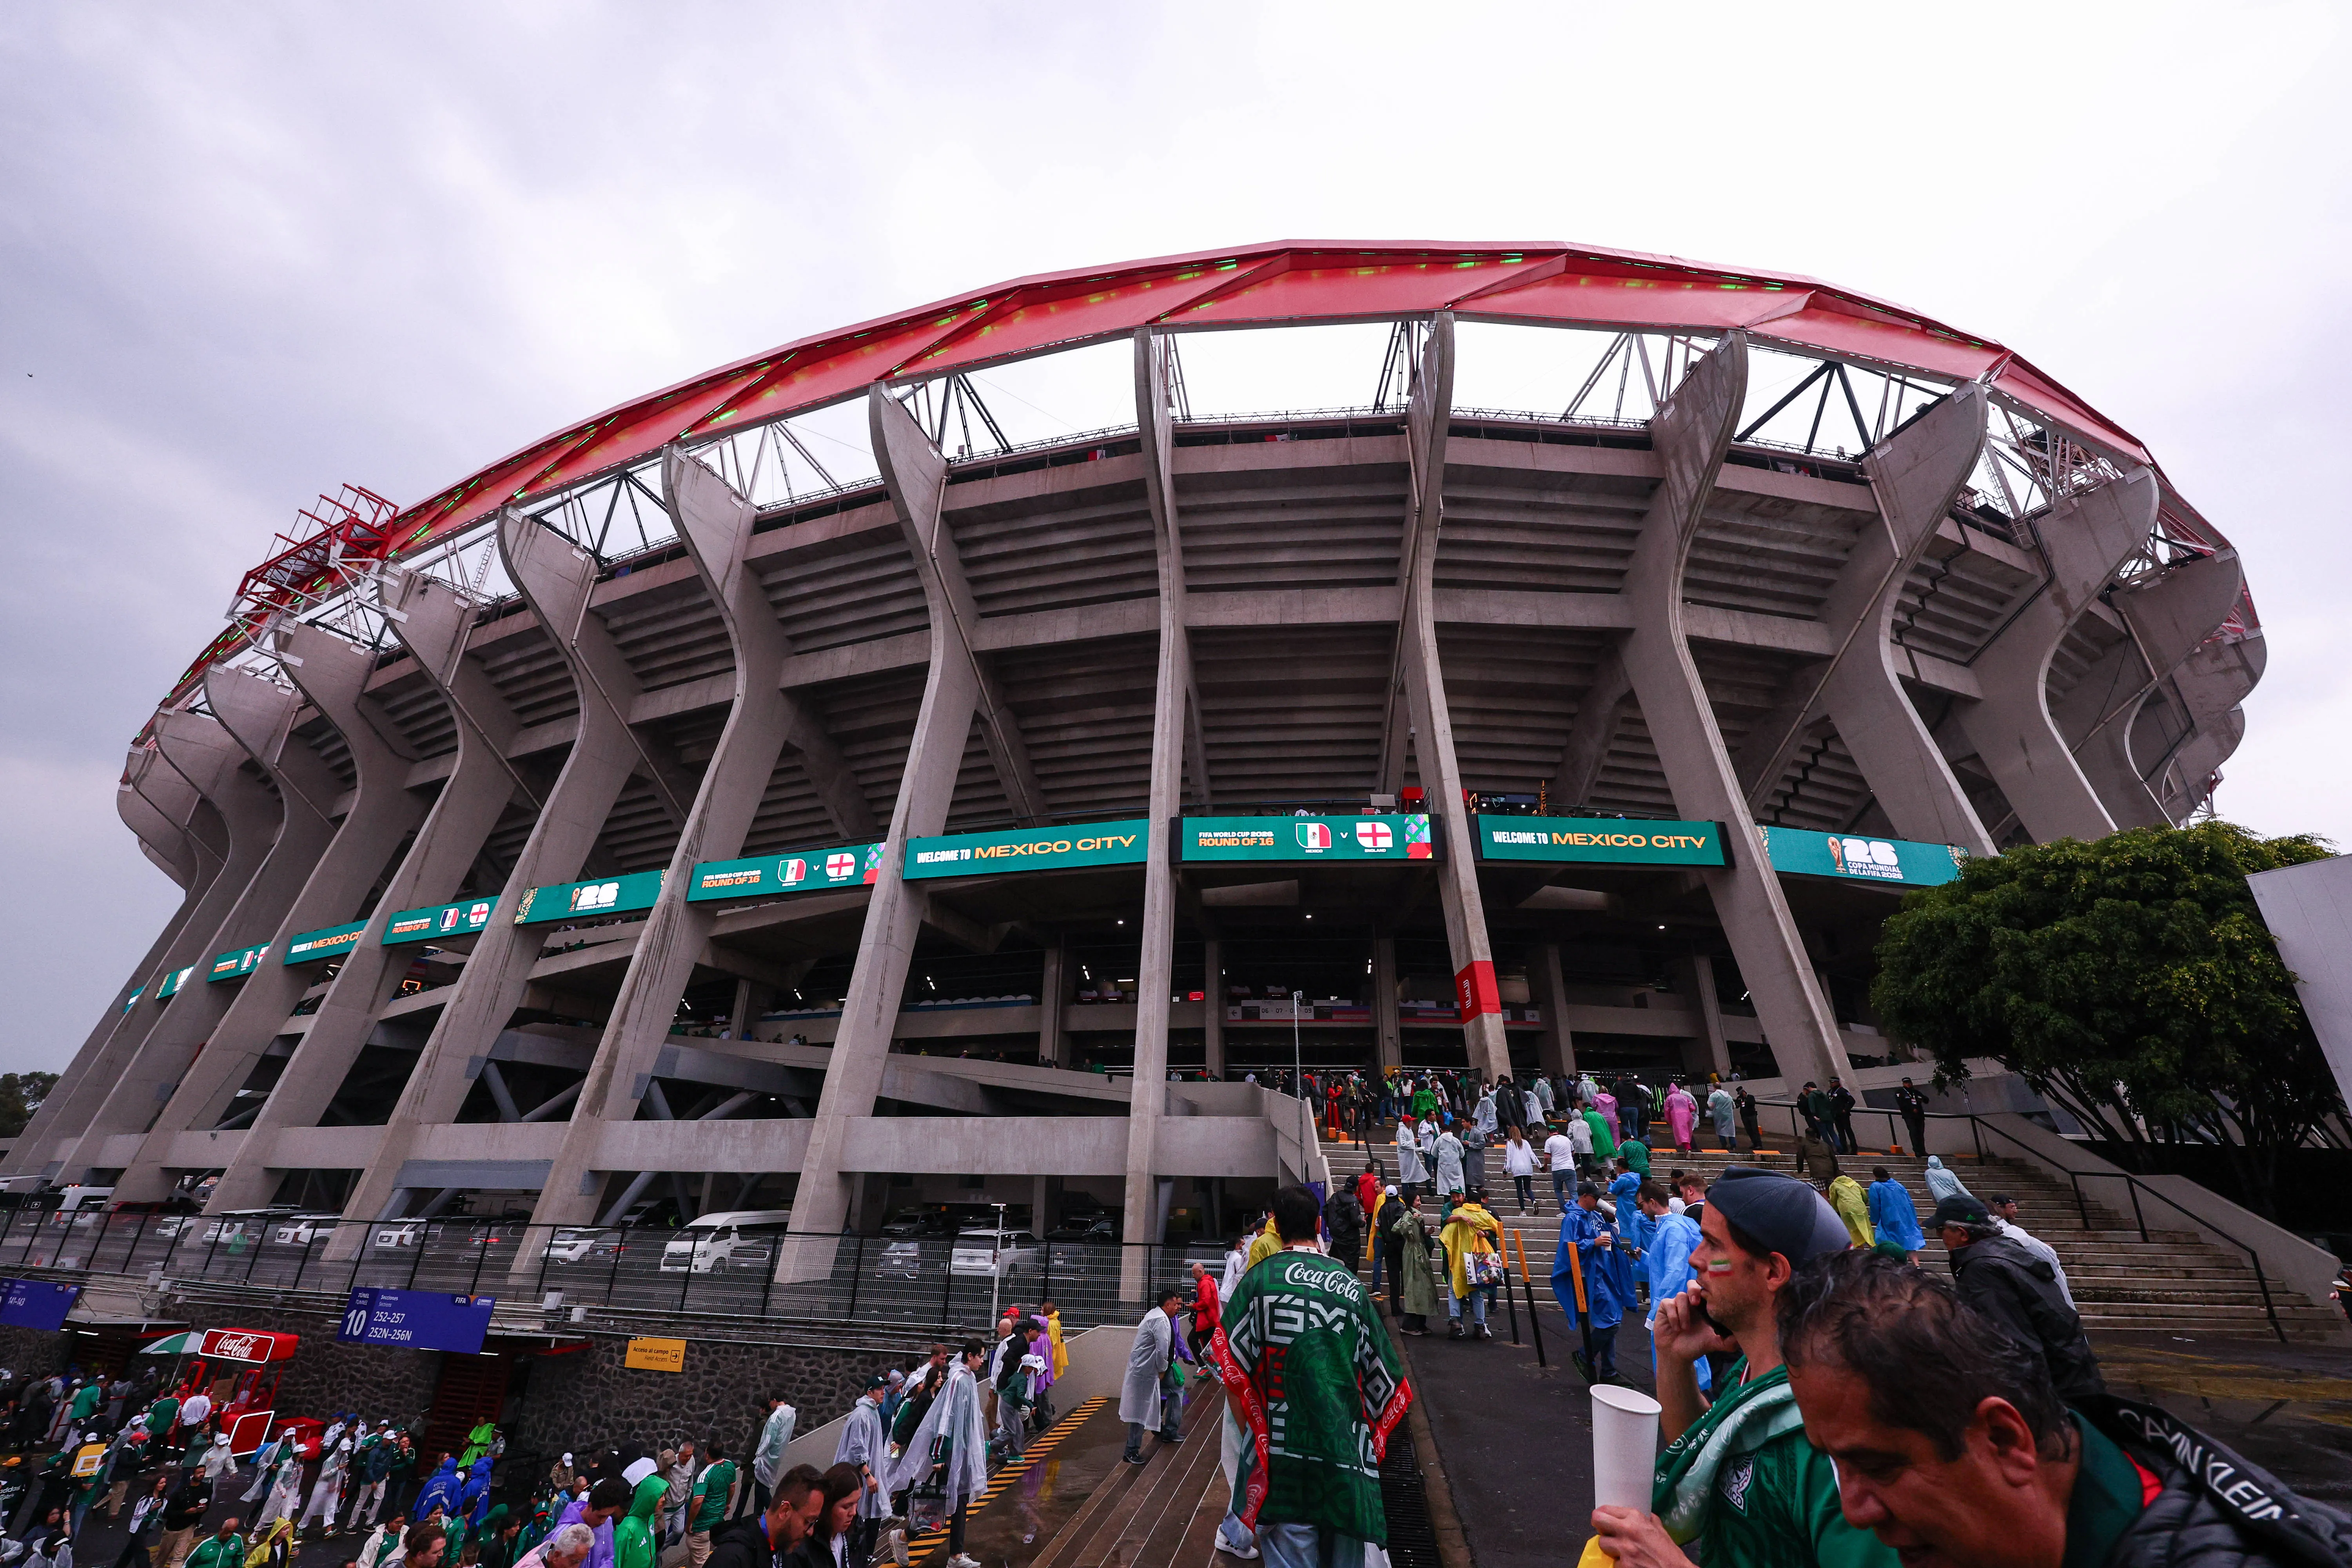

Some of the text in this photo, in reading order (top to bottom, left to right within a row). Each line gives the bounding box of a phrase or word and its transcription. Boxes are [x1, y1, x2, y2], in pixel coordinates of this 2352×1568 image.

[917, 834, 1136, 863] WELCOME TO MEXICO CITY
[1198, 837, 1274, 847] ROUND OF 16
[1492, 831, 1706, 849] WELCOME TO MEXICO CITY
[1842, 838, 1899, 866] 26
[1847, 861, 1902, 873] COPA MUNDIAL
[701, 878, 734, 888] ROUND
[747, 875, 760, 884] 16
[577, 882, 619, 907] 26
[312, 934, 349, 949] MEXICO
[349, 930, 363, 941] CI
[392, 925, 413, 933] ROUND
[1285, 1262, 1361, 1302] Coca-Cola
[345, 1309, 367, 1336] 10
[214, 1333, 259, 1358] Coca-Cola
